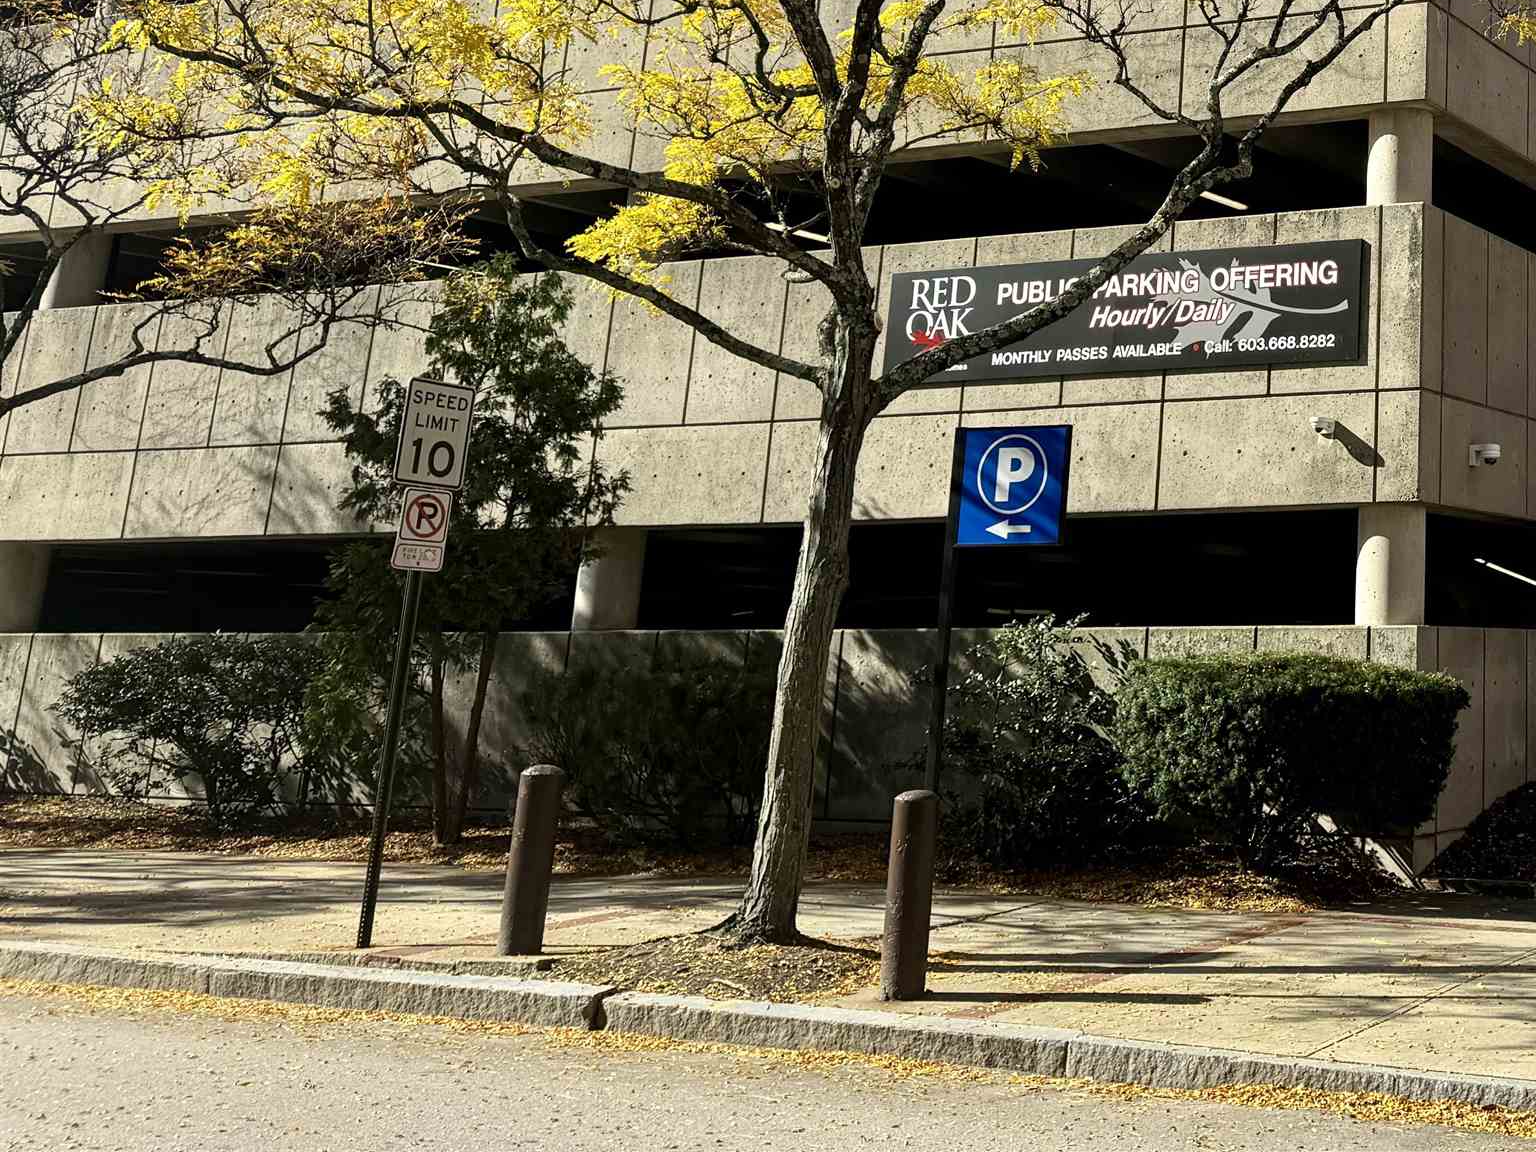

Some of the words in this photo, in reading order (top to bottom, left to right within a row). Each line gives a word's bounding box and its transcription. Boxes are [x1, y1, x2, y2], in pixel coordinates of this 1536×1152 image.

[1210, 260, 1338, 291] OFFERING
[909, 276, 976, 313] RED
[906, 308, 975, 341] OAK
[1089, 299, 1235, 328] Hourly/Daily
[991, 350, 1053, 366] MONTHLY
[1056, 346, 1108, 361] PASSES
[1113, 342, 1182, 358] AVAILABLE
[1204, 340, 1233, 354] Call:
[1238, 334, 1335, 351] 603.668.8282
[413, 390, 468, 411] SPEED
[415, 413, 459, 433] LIMIT
[412, 438, 455, 478] 10
[994, 447, 1034, 502] P
